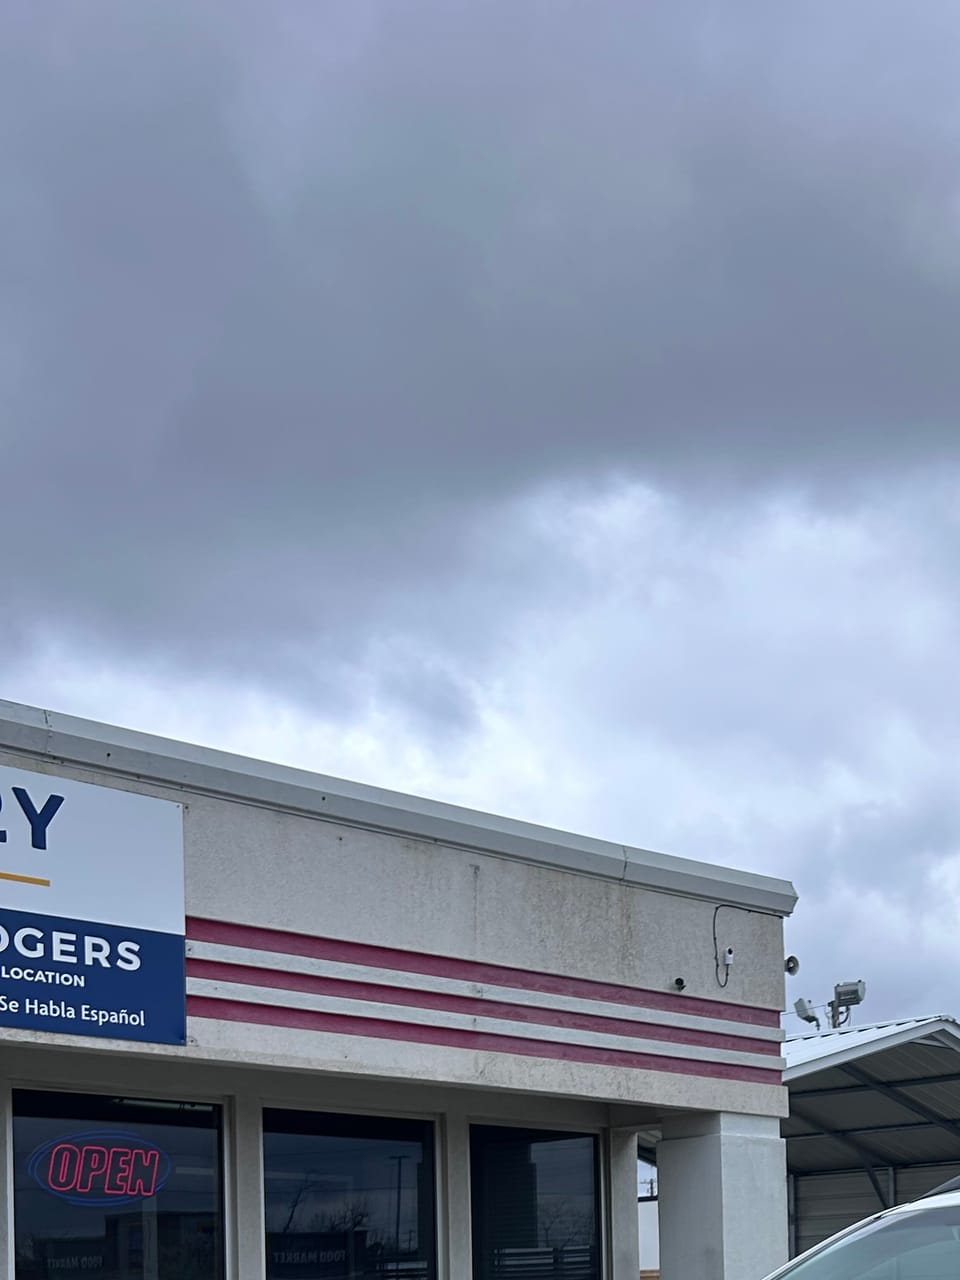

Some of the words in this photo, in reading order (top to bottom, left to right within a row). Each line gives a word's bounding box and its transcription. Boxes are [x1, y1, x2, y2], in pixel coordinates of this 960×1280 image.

[0, 787, 65, 850] Y
[1, 966, 85, 987] LOCATION
[0, 995, 19, 1012] Se
[25, 998, 76, 1018] Habla
[81, 1004, 145, 1026] Español
[48, 1143, 159, 1196] OPEN
